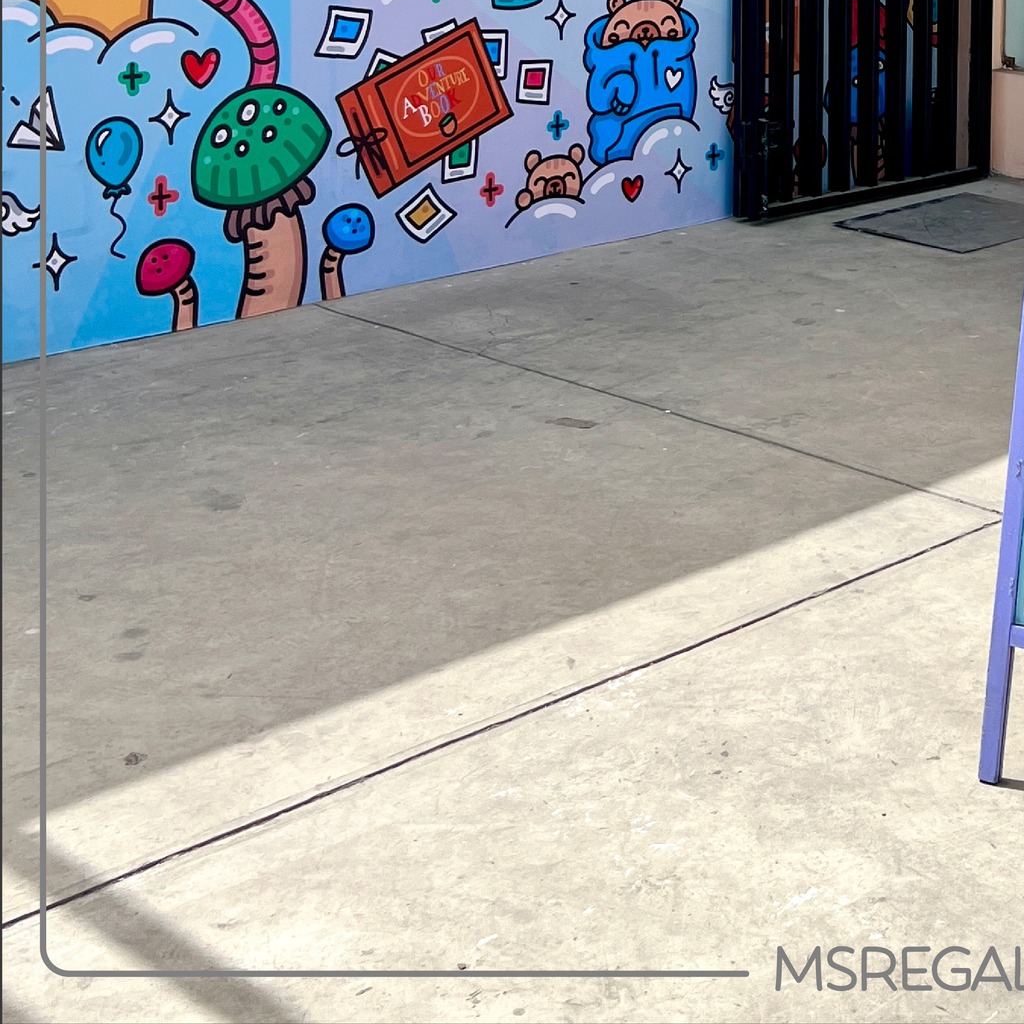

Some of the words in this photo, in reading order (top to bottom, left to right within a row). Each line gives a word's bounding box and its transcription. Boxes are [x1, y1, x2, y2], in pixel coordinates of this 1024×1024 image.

[402, 66, 470, 120] ADVENTURE
[417, 62, 447, 89] OUR
[416, 88, 463, 128] BOOK
